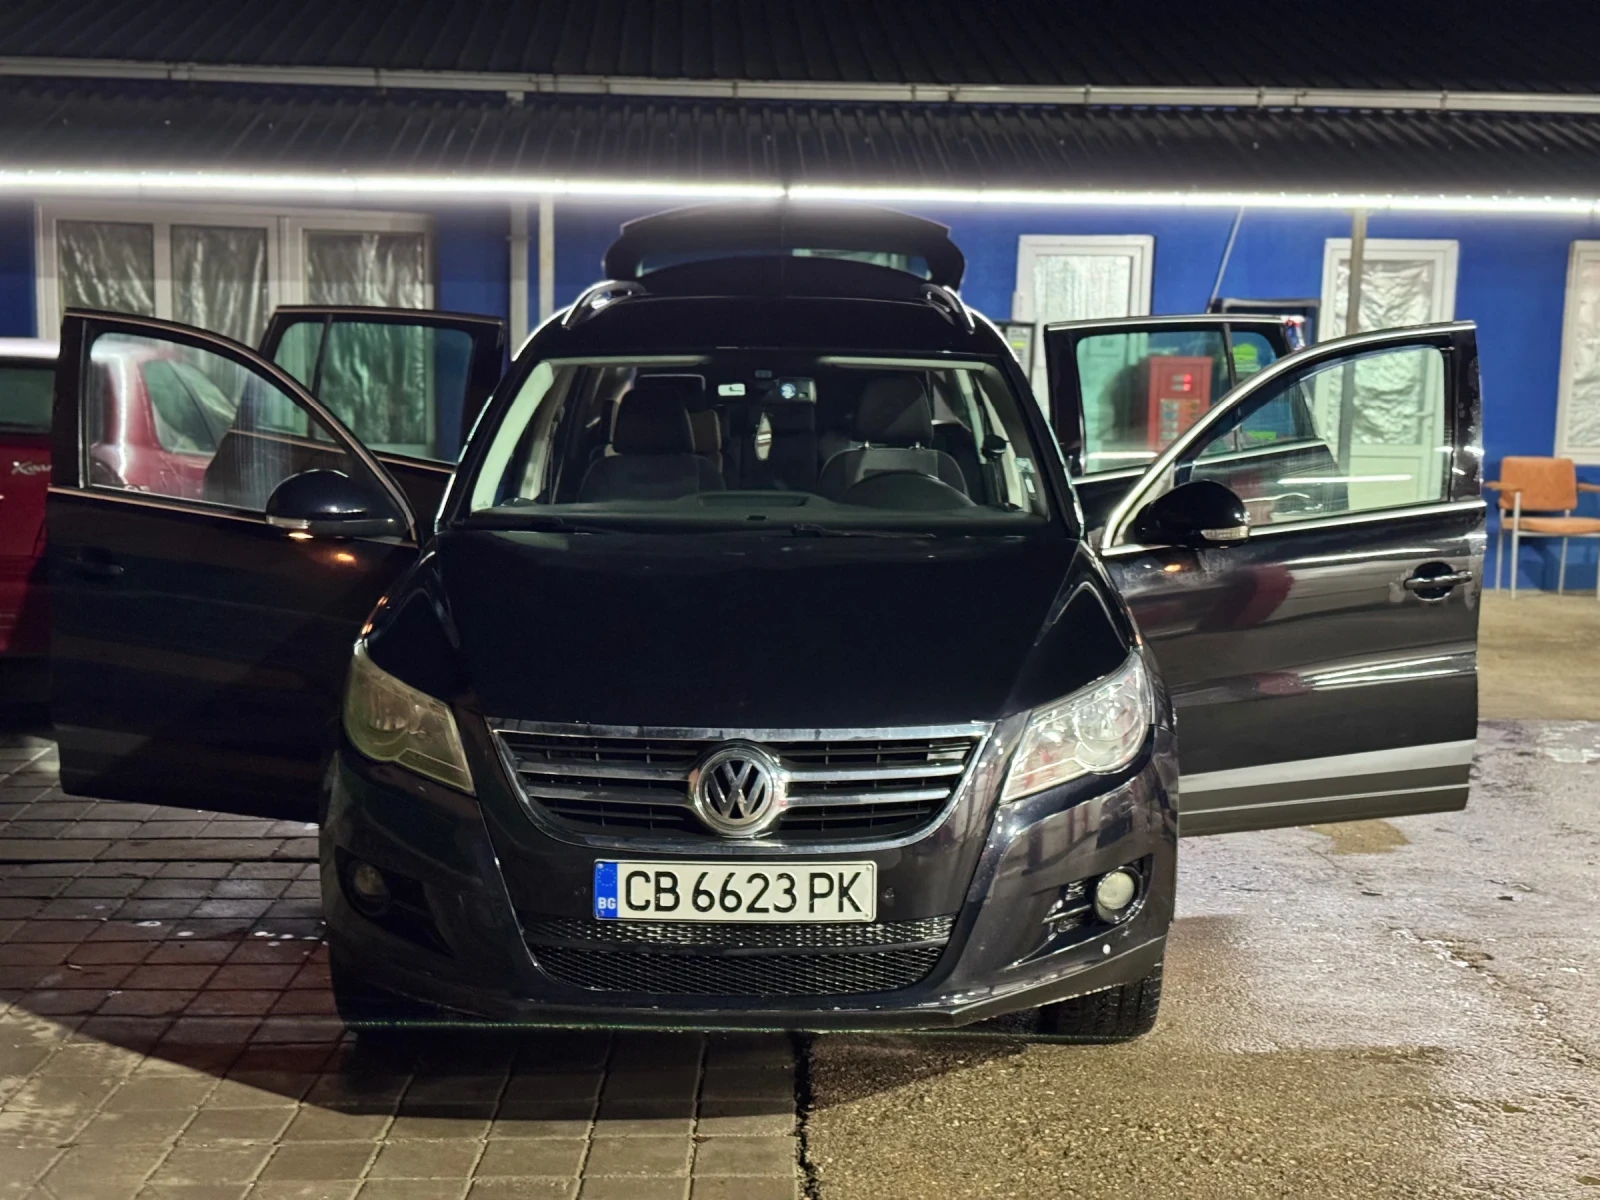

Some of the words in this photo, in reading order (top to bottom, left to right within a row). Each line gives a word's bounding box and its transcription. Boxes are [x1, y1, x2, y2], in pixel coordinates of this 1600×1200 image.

[706, 759, 765, 819] VW
[598, 897, 616, 909] BG
[625, 870, 680, 912] CB
[692, 871, 797, 913] 6623
[808, 872, 863, 913] PK
